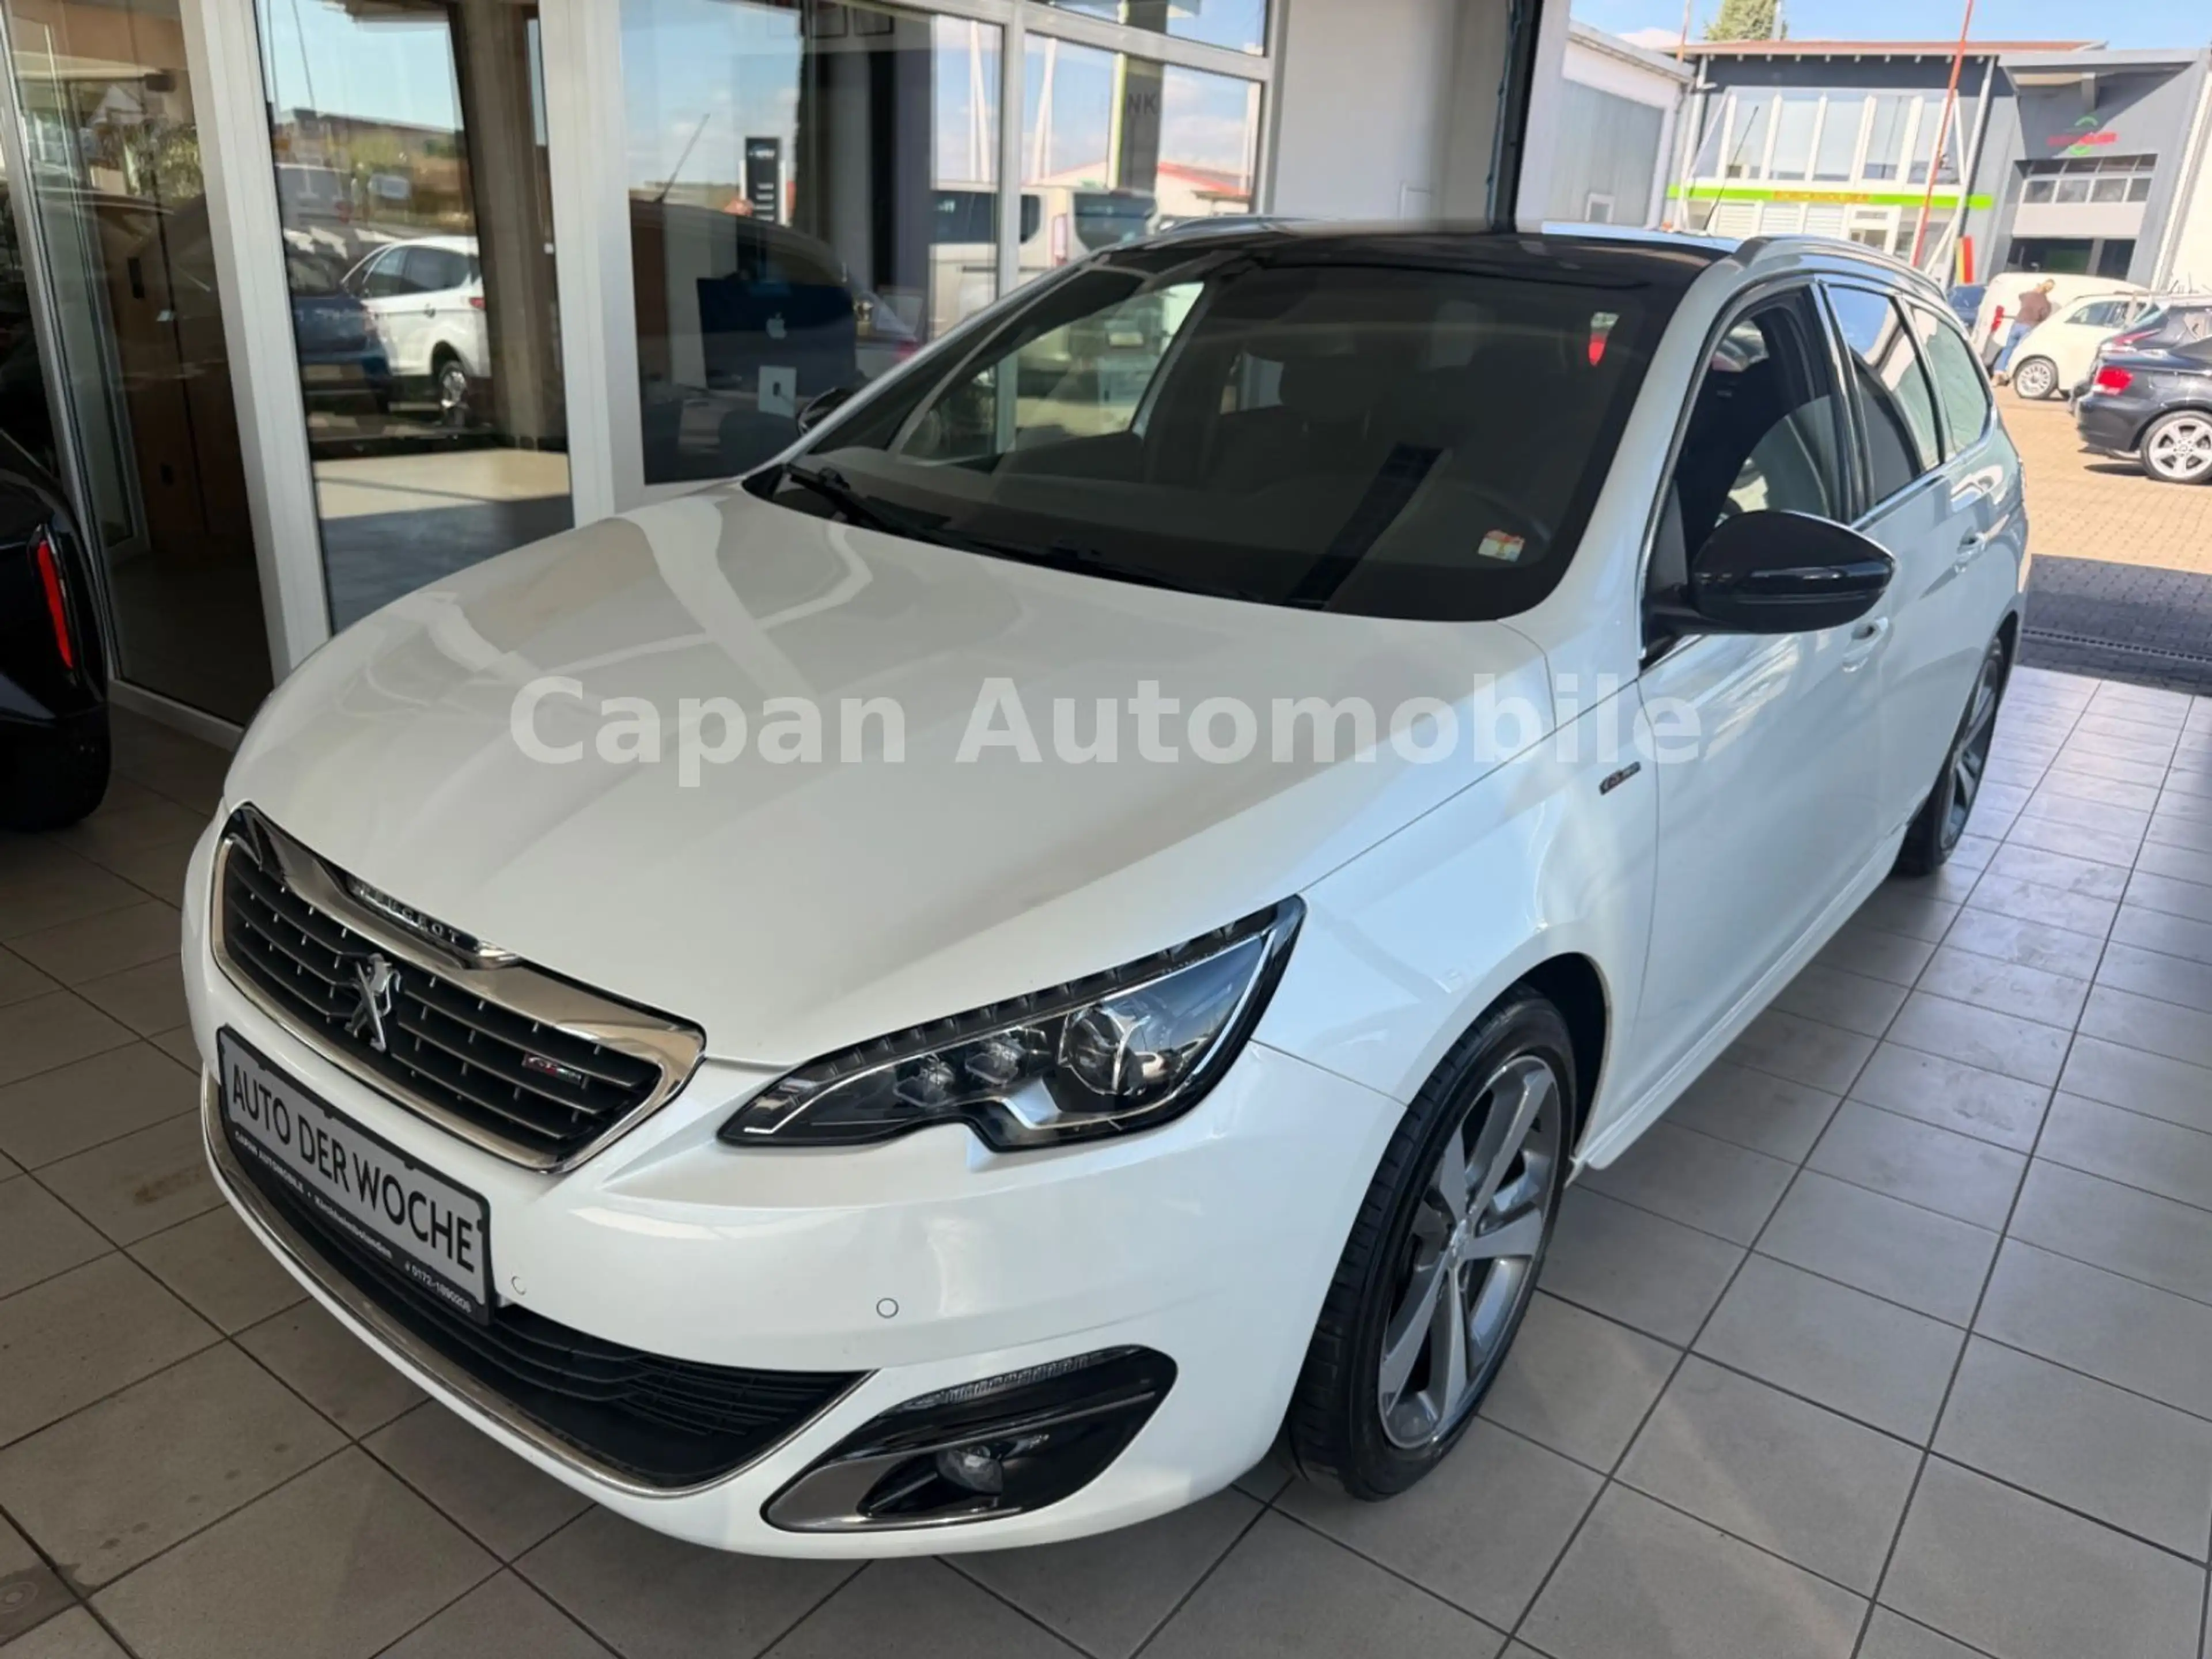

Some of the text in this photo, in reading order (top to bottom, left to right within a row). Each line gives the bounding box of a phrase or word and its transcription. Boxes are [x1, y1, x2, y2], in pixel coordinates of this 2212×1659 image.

[361, 883, 460, 944] PEUGEOT
[233, 1063, 475, 1274] AUTO DER WOCHE
